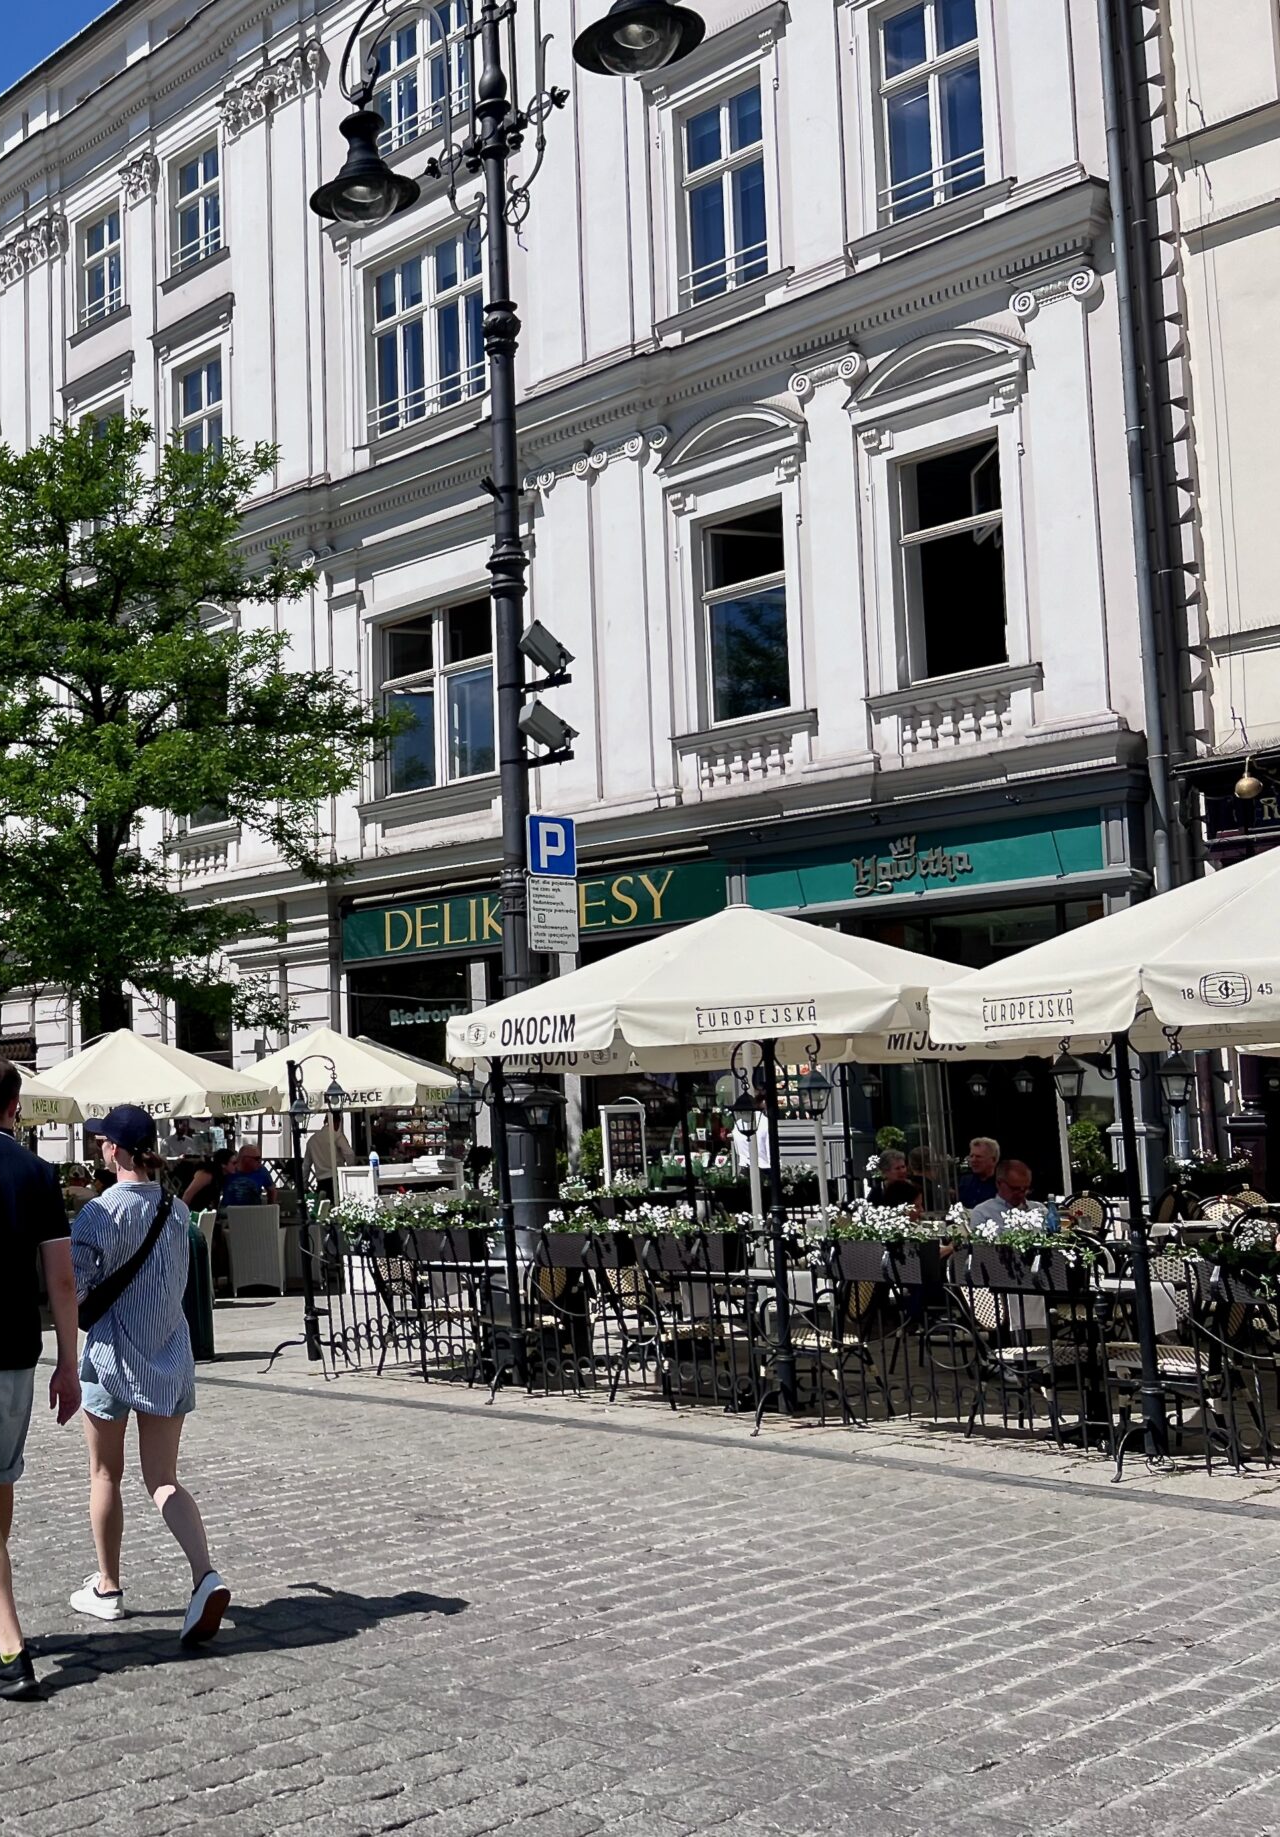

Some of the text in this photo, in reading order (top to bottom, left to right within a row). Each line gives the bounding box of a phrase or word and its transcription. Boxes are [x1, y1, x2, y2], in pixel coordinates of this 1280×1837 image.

[539, 822, 566, 868] P
[384, 870, 675, 952] DELIKESY
[1181, 983, 1273, 1000] 18 45
[389, 1004, 468, 1026] Biedronk
[697, 1005, 817, 1028] EUROPEJSKA
[982, 997, 1074, 1023] EUROPEJSKA
[501, 1014, 576, 1047] OKOCIM
